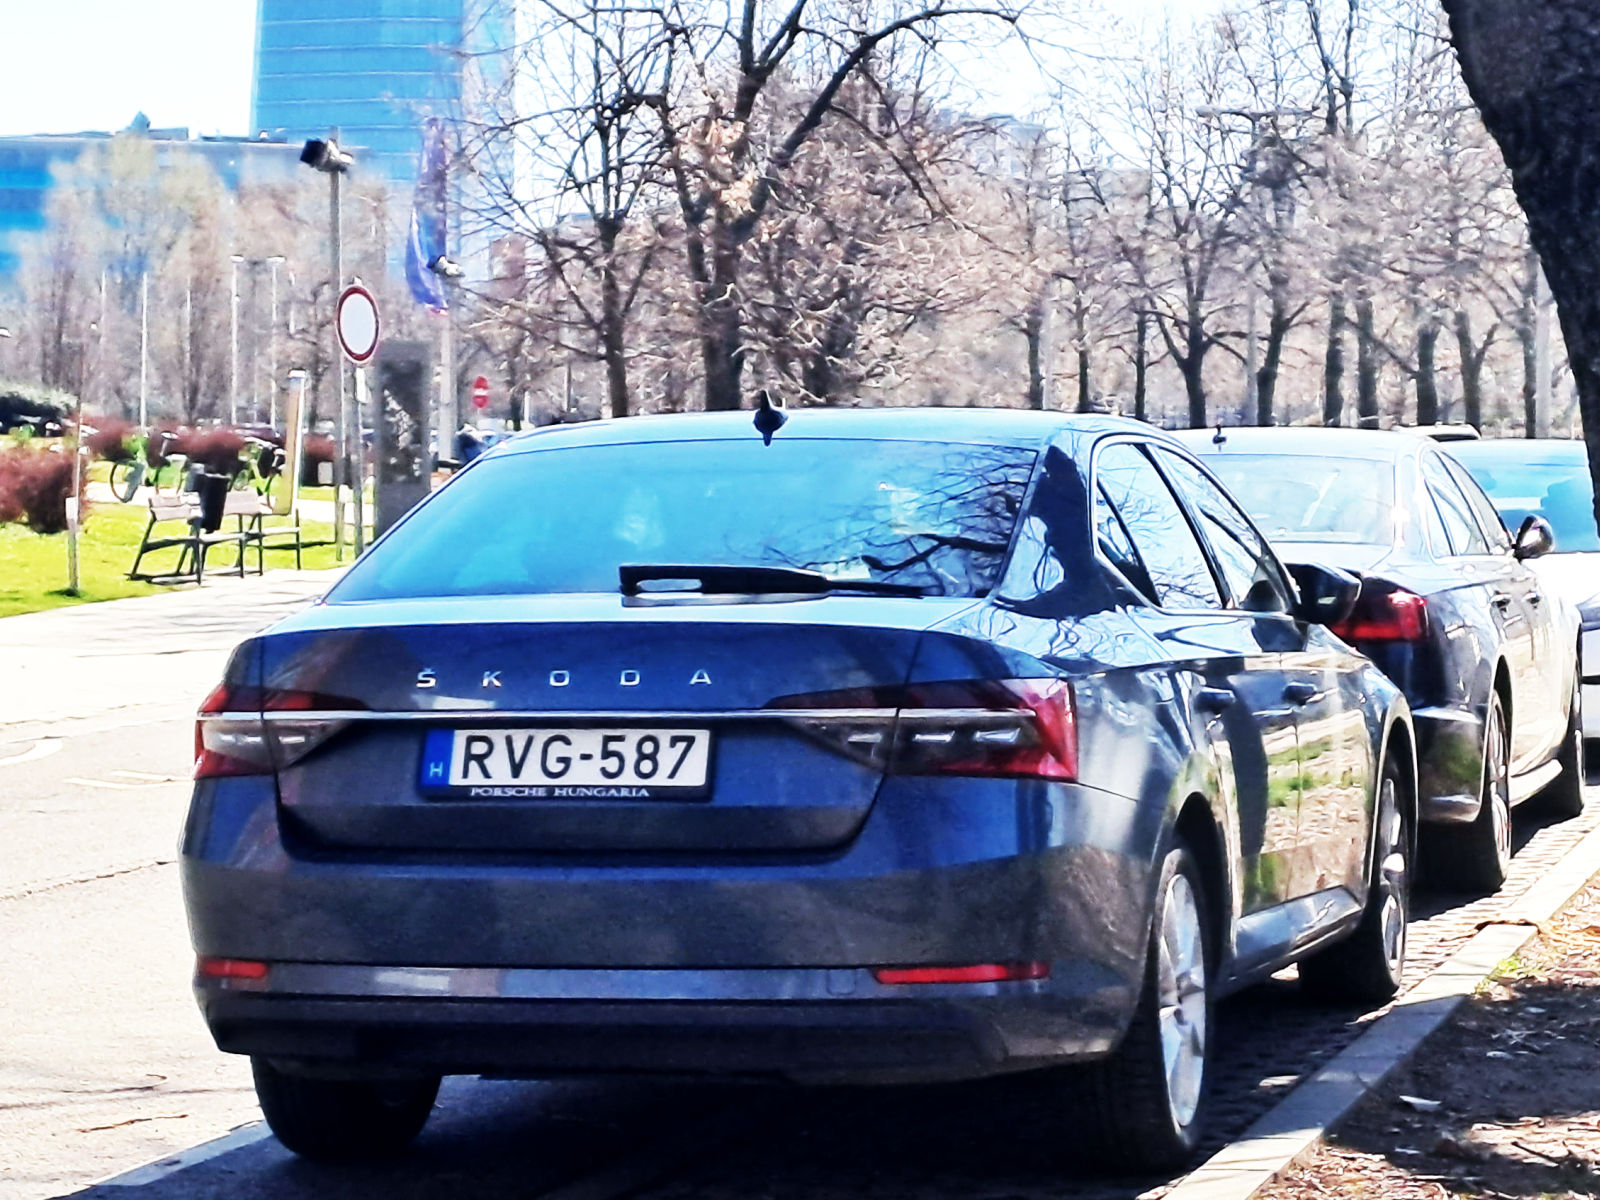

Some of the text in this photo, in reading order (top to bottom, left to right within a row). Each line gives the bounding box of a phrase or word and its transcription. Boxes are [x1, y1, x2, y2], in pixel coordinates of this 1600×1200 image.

[416, 668, 712, 687] ŠKODA
[461, 734, 697, 780] RVG-587
[429, 762, 443, 777] H
[470, 786, 650, 797] PORSCHE HUNGARIA
